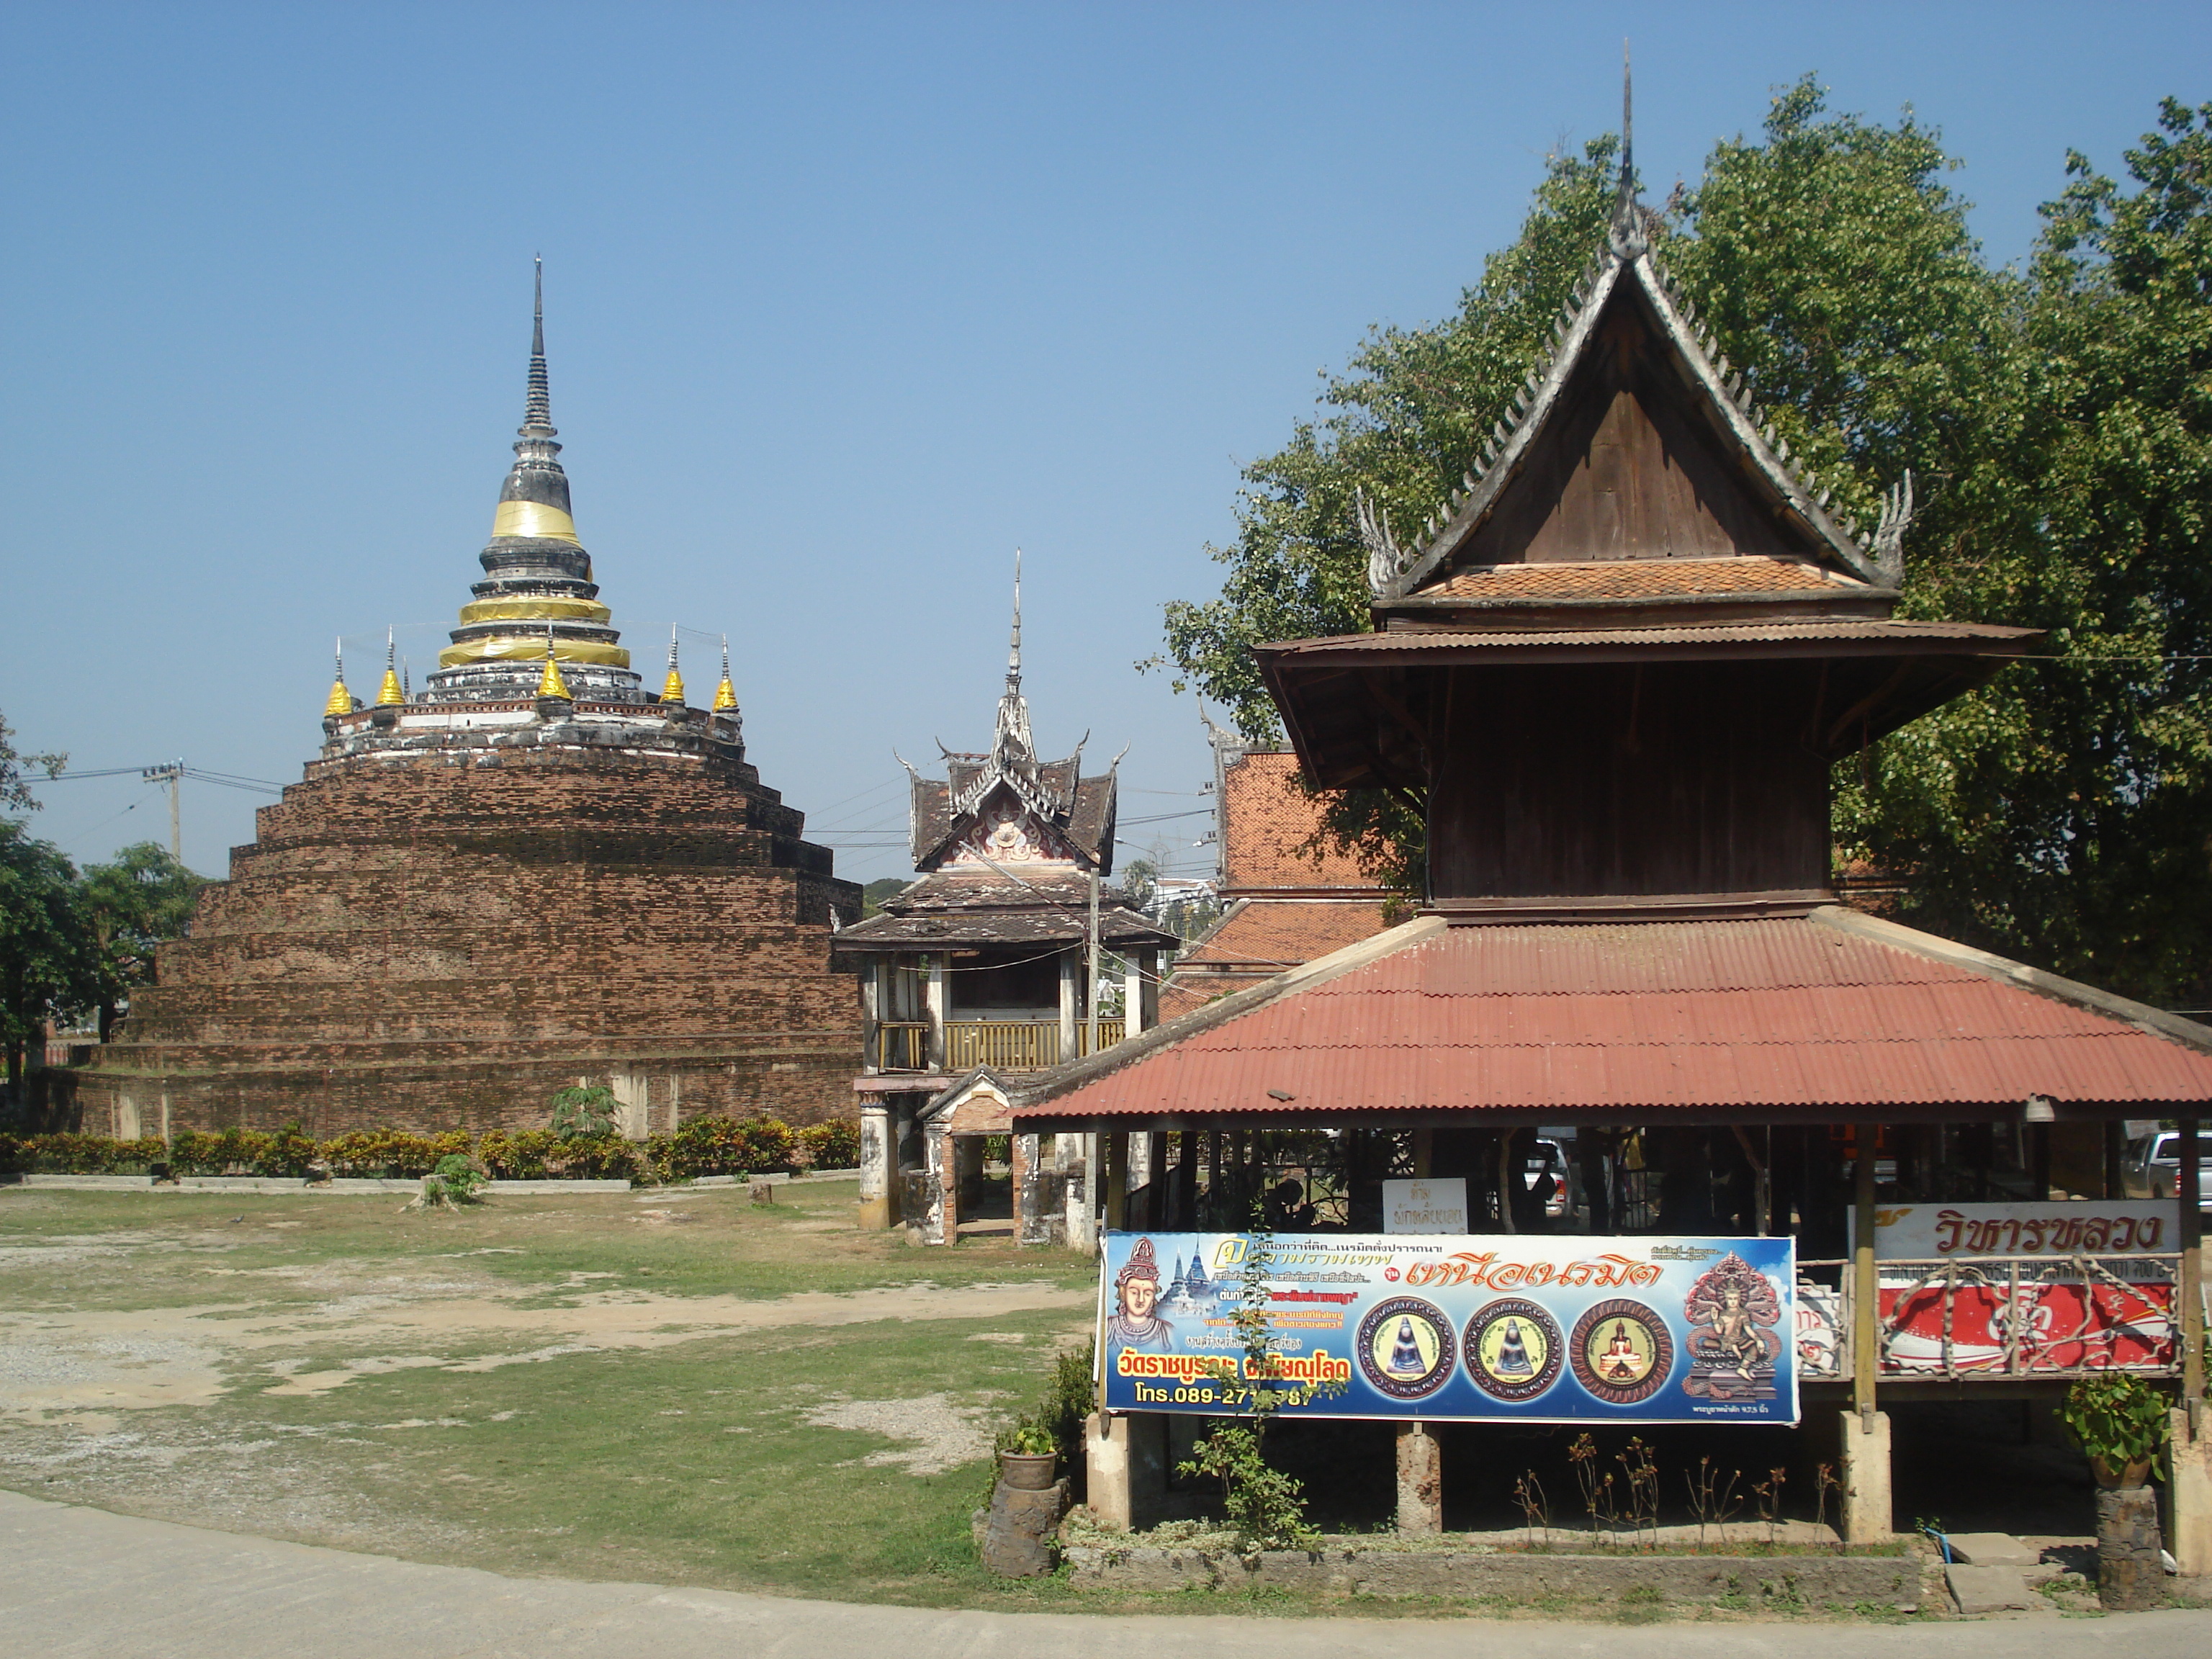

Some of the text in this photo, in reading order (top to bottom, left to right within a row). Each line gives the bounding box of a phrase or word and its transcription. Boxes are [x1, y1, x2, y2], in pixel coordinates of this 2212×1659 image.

[1936, 1210, 2163, 1254] วิหารหลวง
[1405, 1252, 1665, 1292] เหนือเนรมิต
